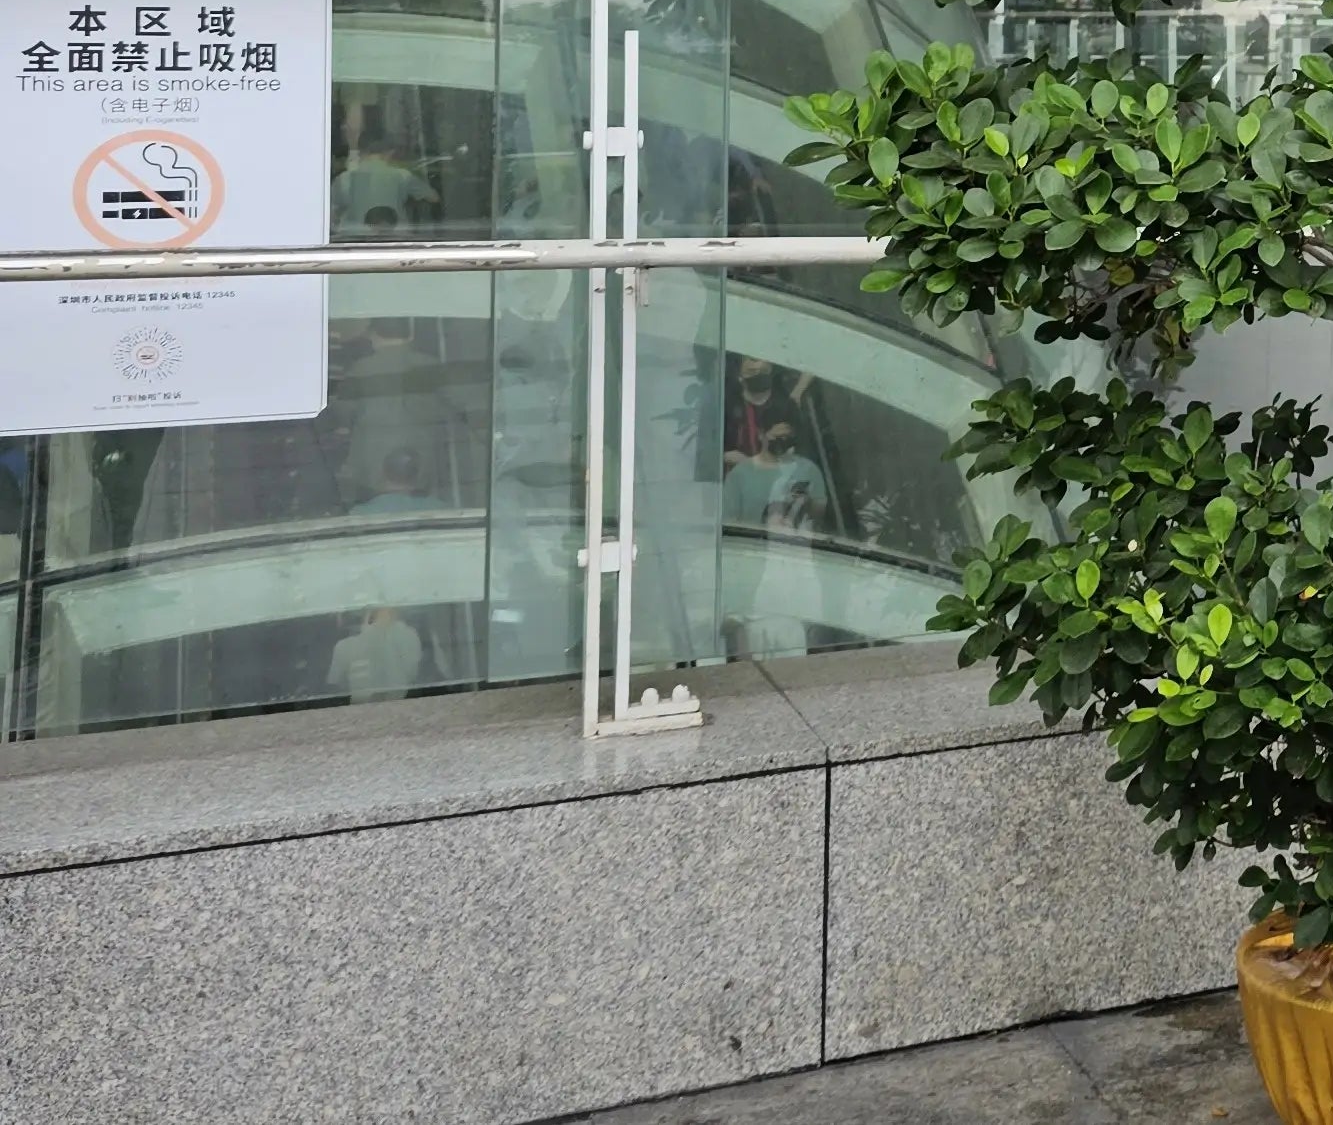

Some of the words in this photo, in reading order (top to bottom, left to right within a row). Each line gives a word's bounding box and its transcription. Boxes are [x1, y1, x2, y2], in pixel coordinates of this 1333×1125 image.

[21, 40, 278, 73] 全面禁止吸烟
[16, 75, 65, 92] This
[73, 79, 124, 92] area
[132, 75, 149, 92] is
[157, 75, 282, 92] smoke-free
[206, 290, 237, 300] 12345
[176, 302, 203, 311] 12345
